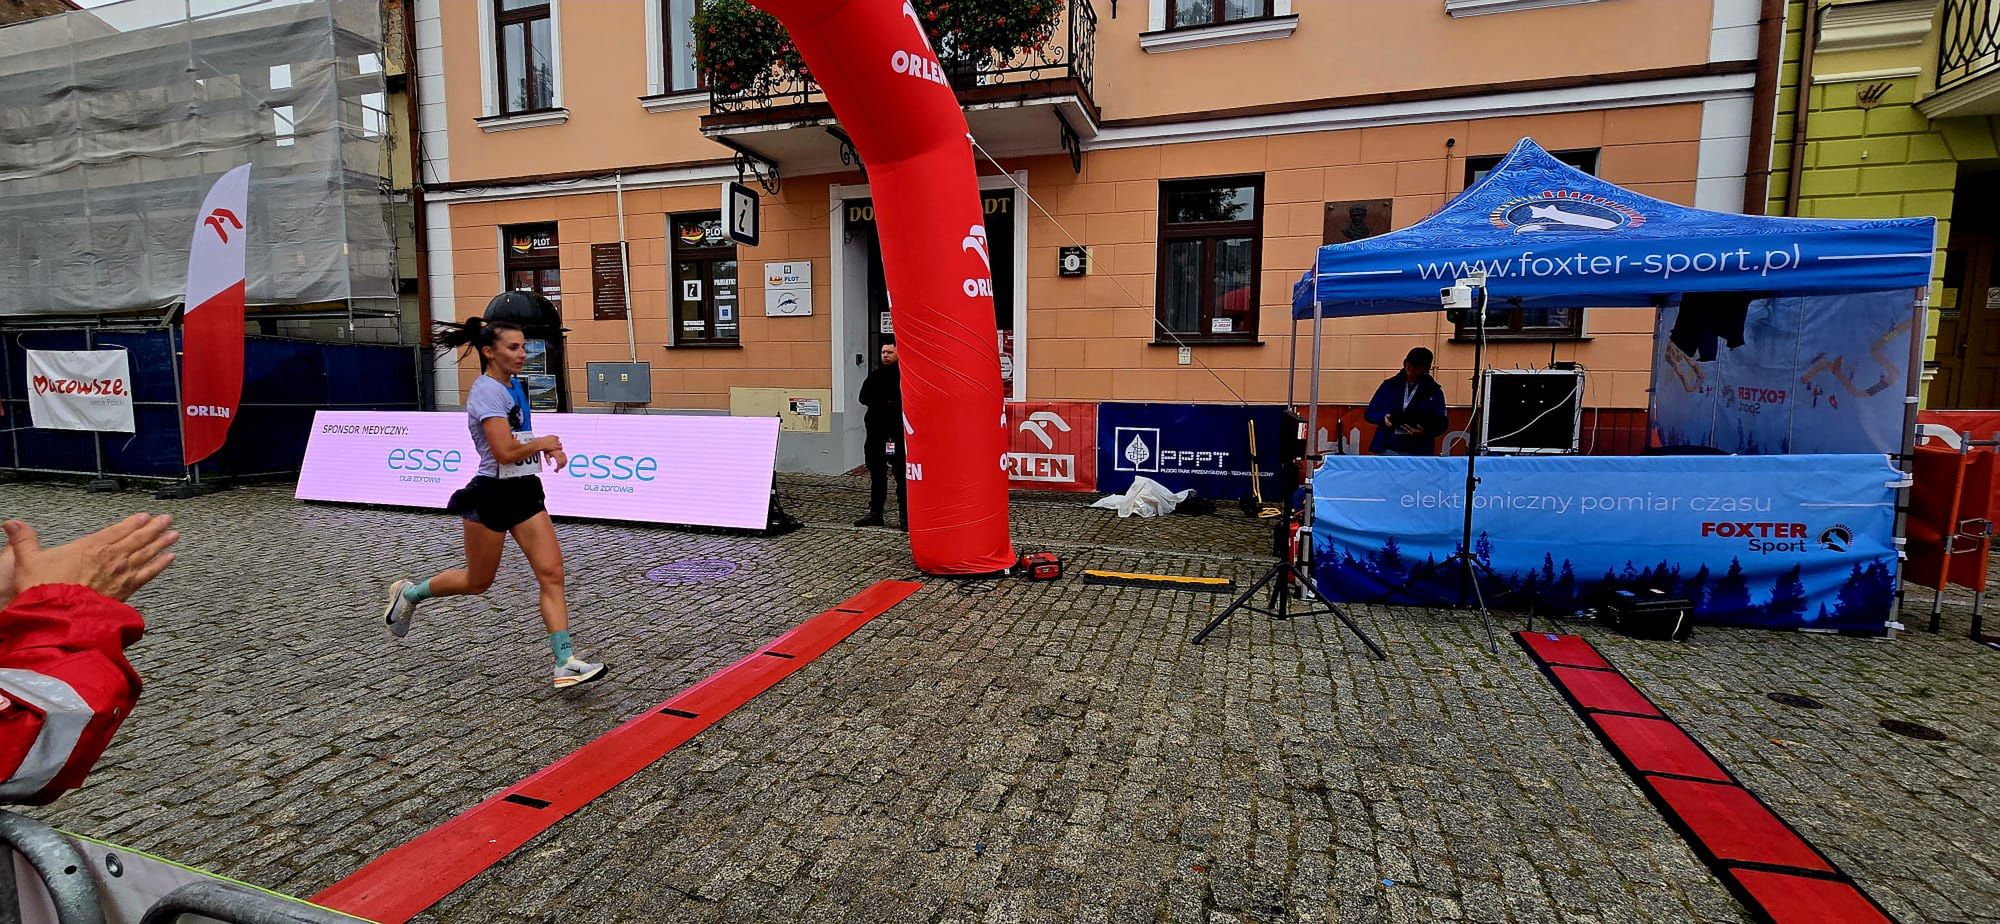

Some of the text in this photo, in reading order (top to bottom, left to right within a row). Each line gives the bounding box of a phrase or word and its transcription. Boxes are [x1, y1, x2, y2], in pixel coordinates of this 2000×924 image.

[891, 50, 949, 88] ORLEN
[850, 206, 874, 222] DO
[705, 228, 723, 237] PLO
[533, 238, 551, 247] PLOT
[1416, 243, 1800, 280] www.foxter-sport.pl
[186, 405, 230, 418] ORLEN
[322, 424, 409, 436] SPONSOR MEDYCZNY:
[387, 447, 461, 473] esse
[568, 453, 658, 482] esse
[1008, 457, 1069, 478] RLEN
[1160, 450, 1230, 468] PPPT
[1580, 490, 1678, 515] pomiar
[1689, 495, 1772, 513] czasu
[1701, 521, 1809, 540] FOXTER
[1749, 538, 1808, 556] Sport
